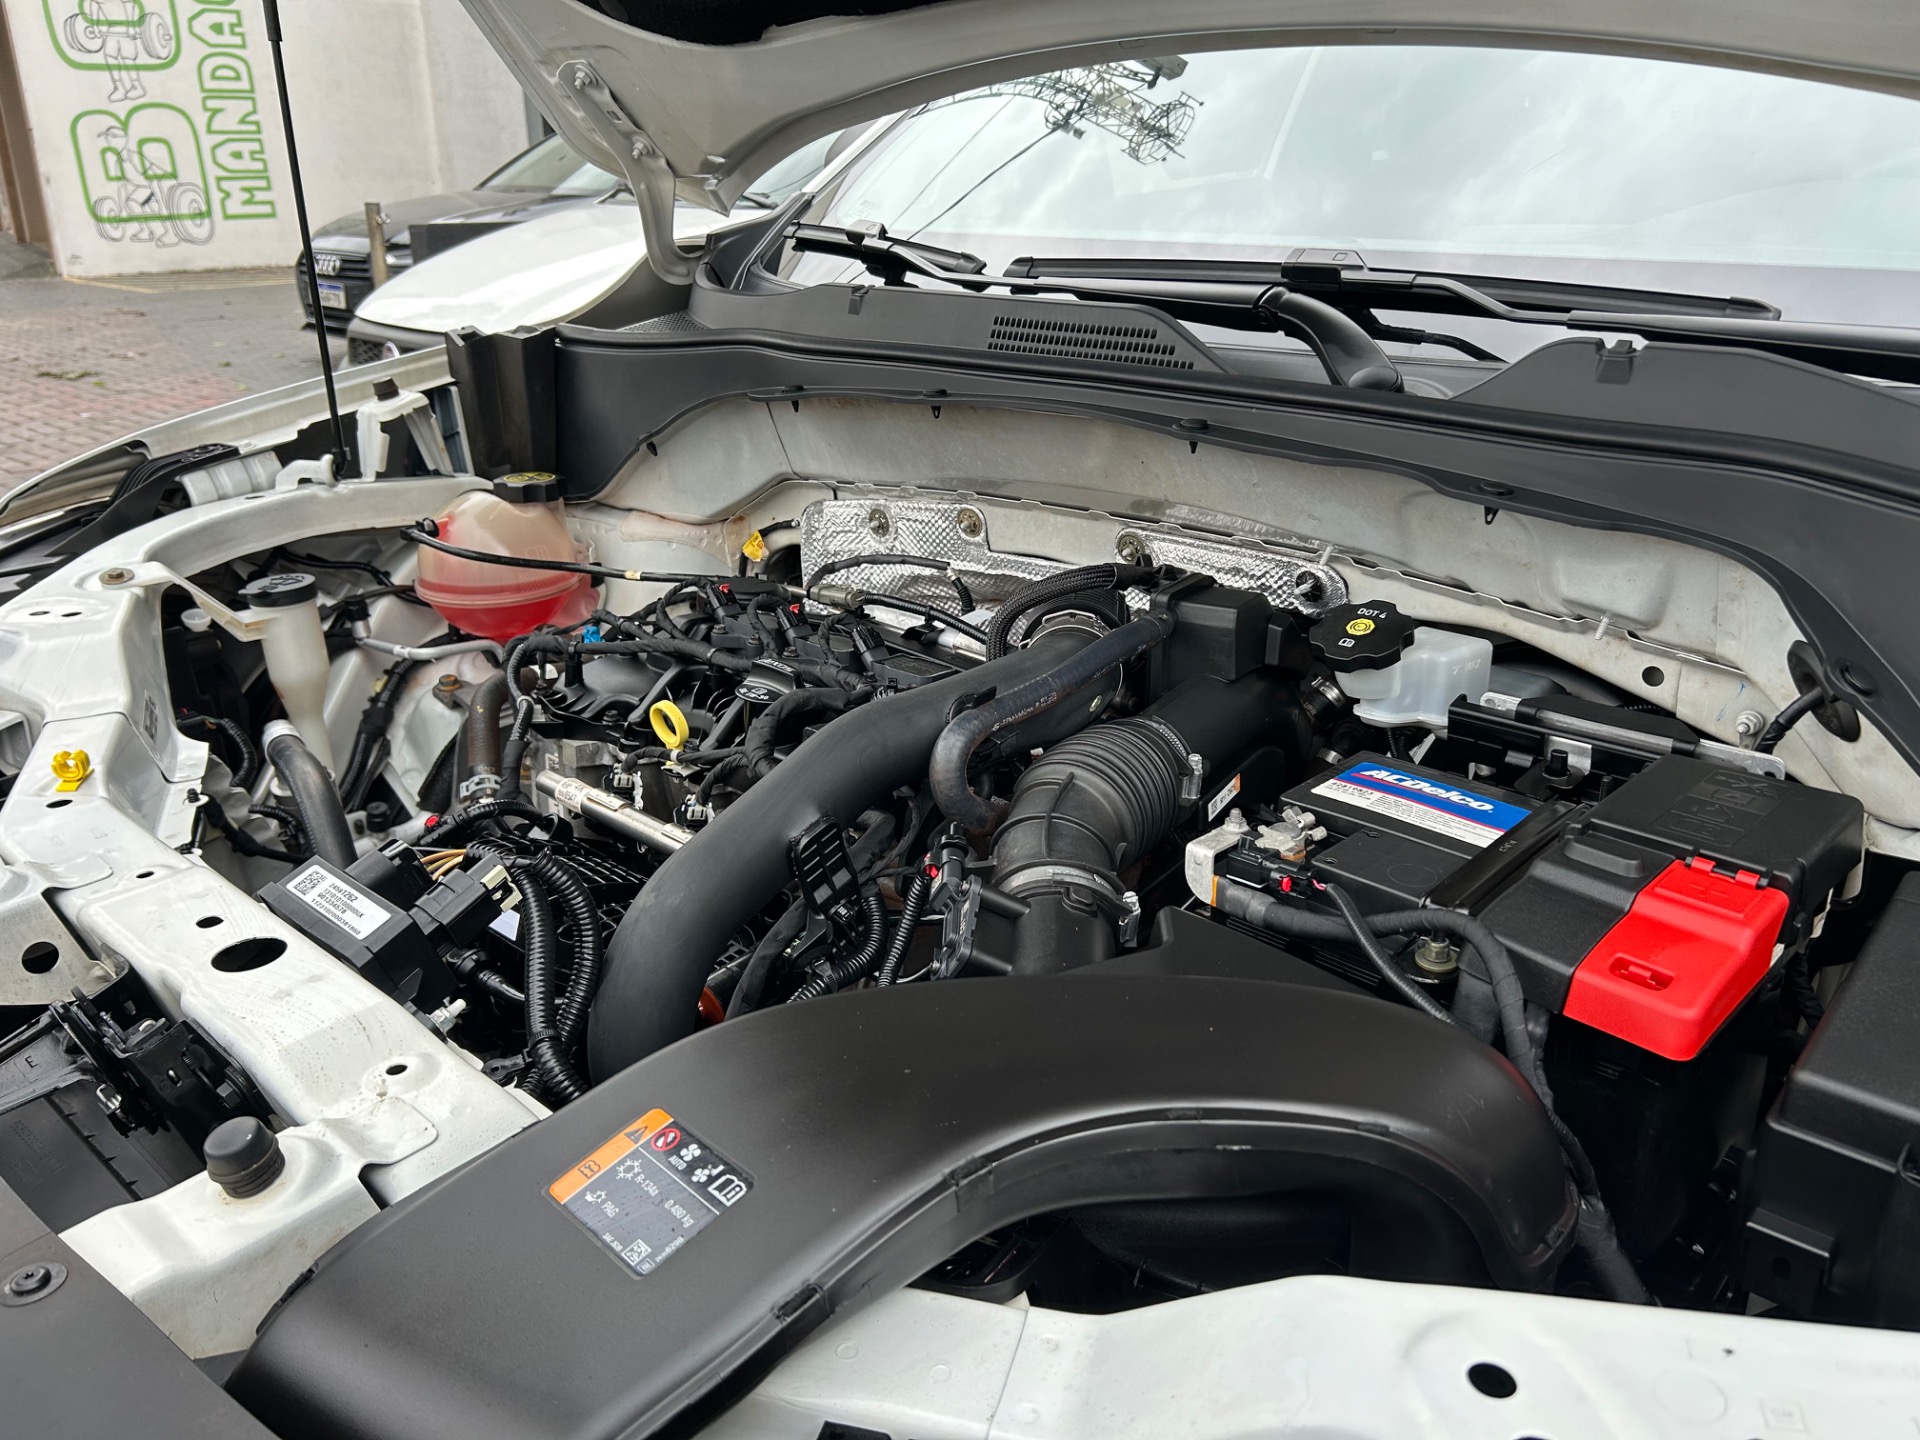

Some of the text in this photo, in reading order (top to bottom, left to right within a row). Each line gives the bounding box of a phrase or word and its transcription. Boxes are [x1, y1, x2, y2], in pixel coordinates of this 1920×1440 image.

[187, 0, 276, 220] MANDA
[1357, 607, 1380, 618] DOT
[1359, 768, 1493, 812] ACDelco
[25, 1055, 38, 1069] E
[668, 1154, 687, 1171] AUTO
[601, 1200, 620, 1218] PAG
[633, 1173, 659, 1198] R-134a
[683, 1213, 695, 1229] kg
